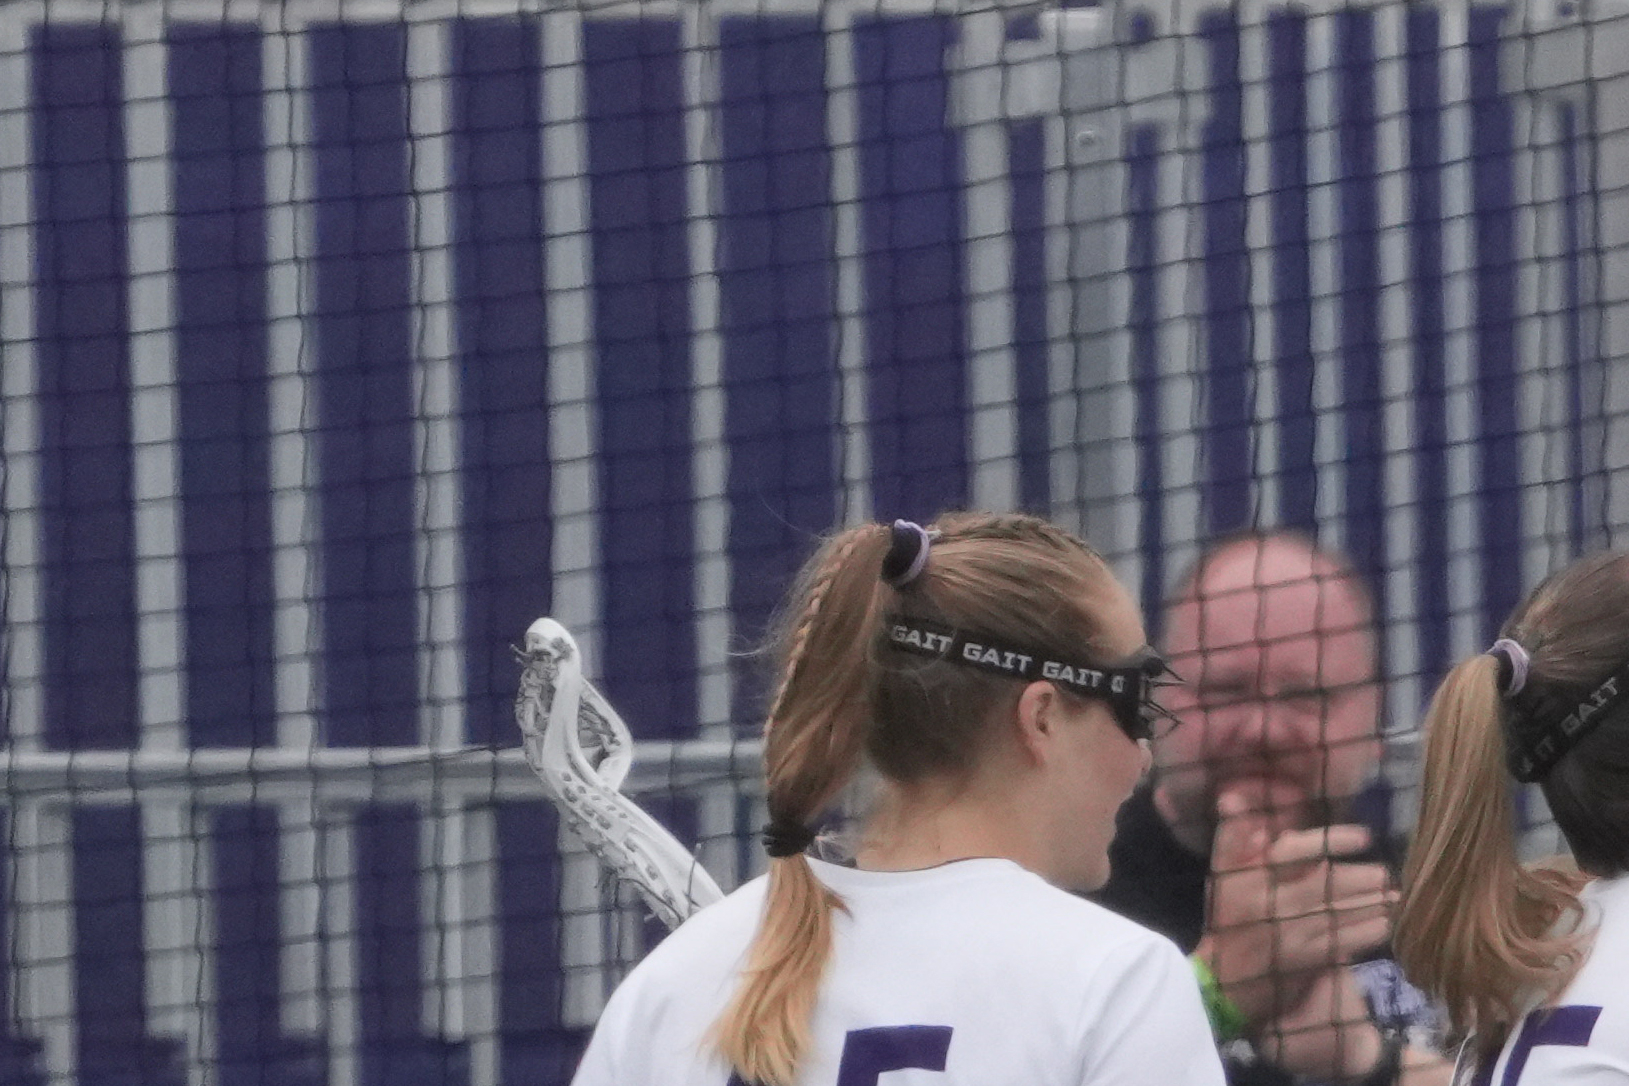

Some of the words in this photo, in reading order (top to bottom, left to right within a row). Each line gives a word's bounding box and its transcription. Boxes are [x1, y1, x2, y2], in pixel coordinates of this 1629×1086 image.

[892, 624, 952, 653] GAIT
[962, 642, 1032, 675] GAIT
[1042, 661, 1102, 689] GAIT
[1560, 677, 1618, 737] GAIT
